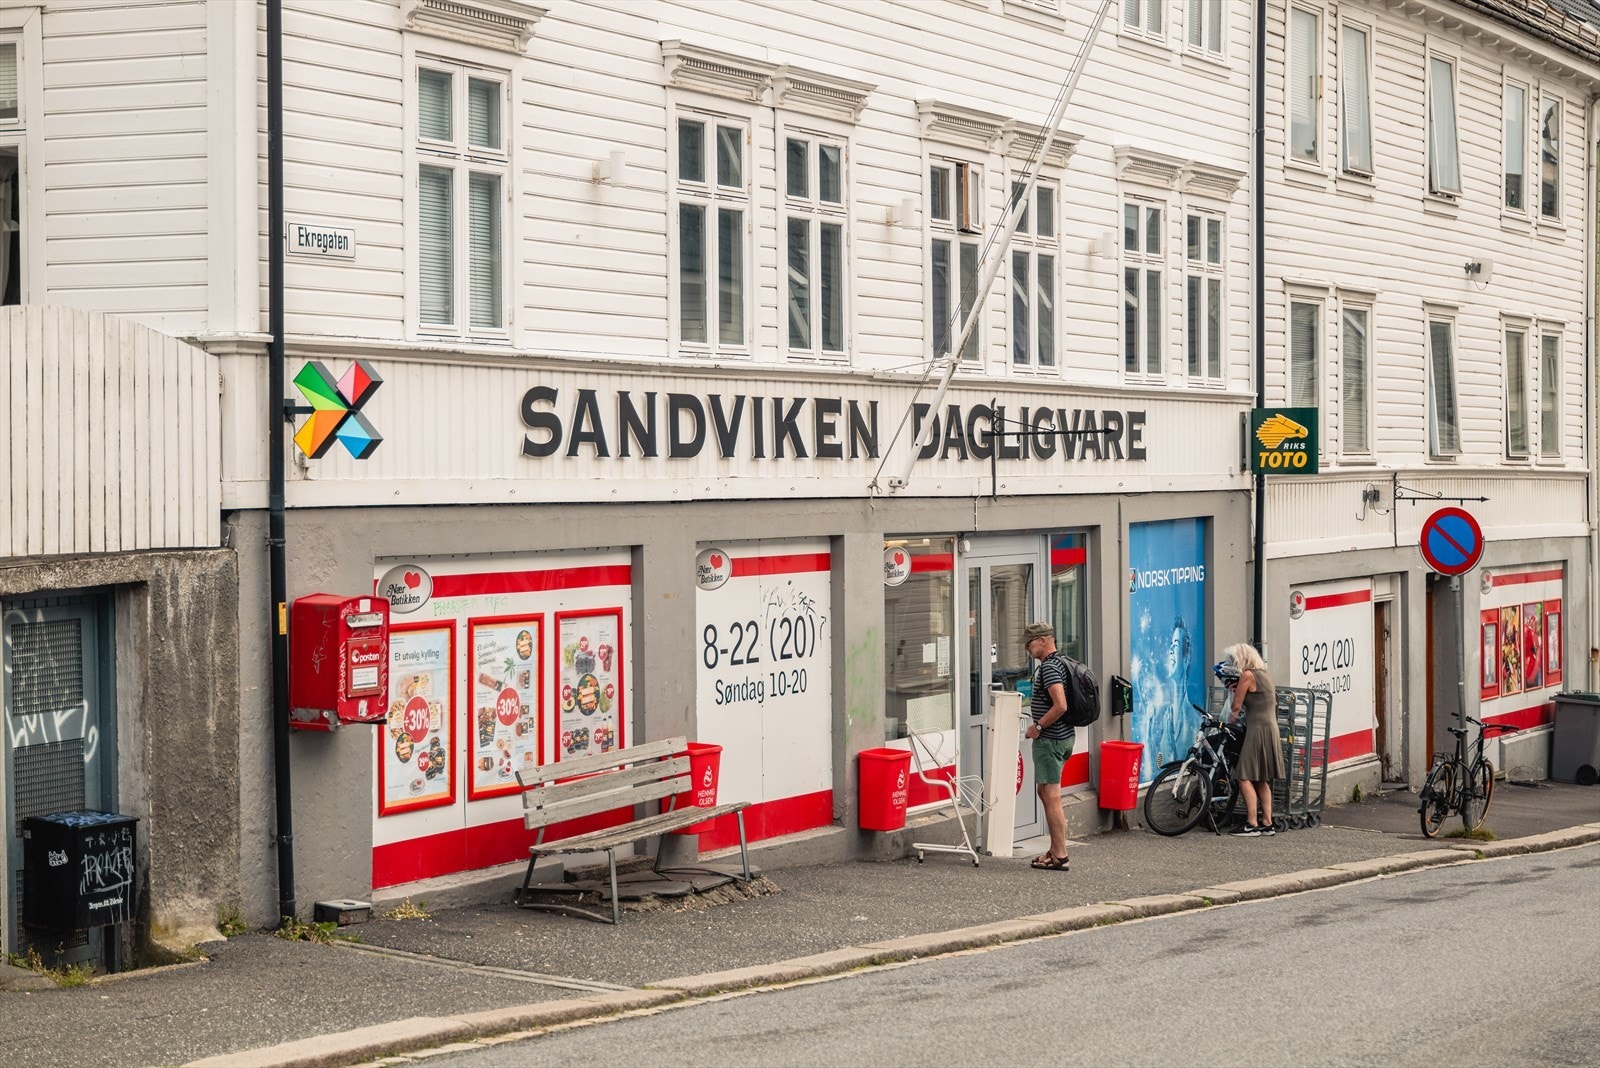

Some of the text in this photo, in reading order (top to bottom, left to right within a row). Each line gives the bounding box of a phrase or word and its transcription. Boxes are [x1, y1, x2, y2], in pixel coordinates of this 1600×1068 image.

[297, 226, 349, 253] Ekregaten
[520, 385, 1147, 462] SANDVIKEN DAGLIGVARE
[1283, 442, 1306, 450] RIKS
[1259, 451, 1308, 469] TOTO
[1137, 565, 1205, 589] NORSK TIPPING
[386, 584, 406, 597] Nær
[391, 593, 421, 606] Butikken
[703, 614, 816, 669] 8-22 (20)
[359, 653, 380, 664] posten
[394, 652, 401, 661] Et
[402, 651, 420, 661] utvalg
[1302, 637, 1355, 675] 8-22 (20)
[714, 668, 808, 706] Søndag 10-20
[1331, 674, 1351, 694] 10-20
